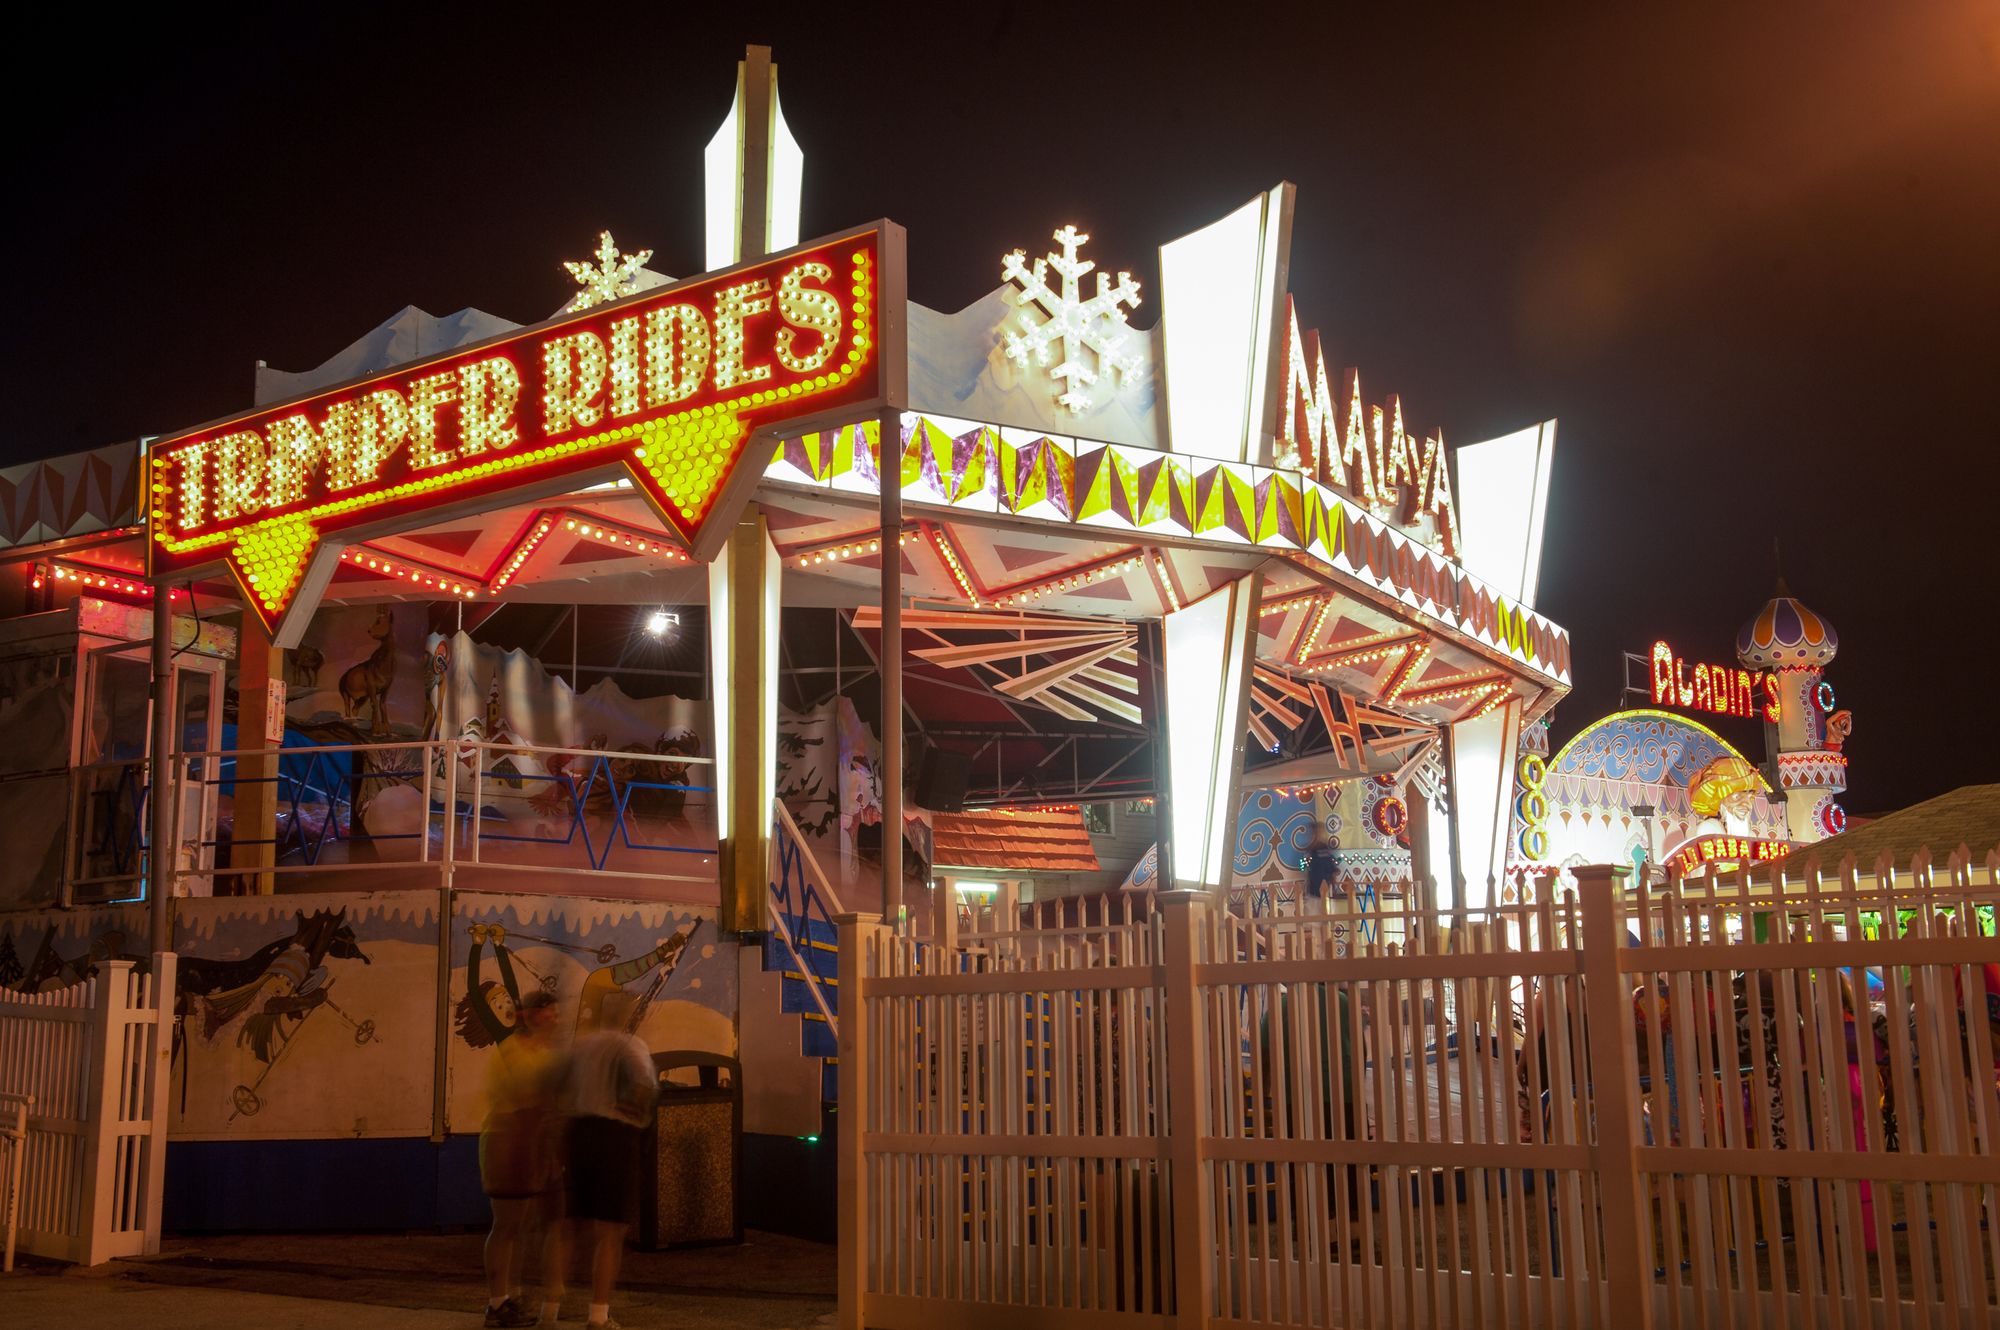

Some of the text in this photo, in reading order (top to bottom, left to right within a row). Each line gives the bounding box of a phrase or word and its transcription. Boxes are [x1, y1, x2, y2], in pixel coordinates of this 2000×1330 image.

[168, 261, 842, 531] TRIMPER RIDES
[1650, 640, 1781, 723] ALADIN'S
[1701, 837, 1750, 860] BABA
